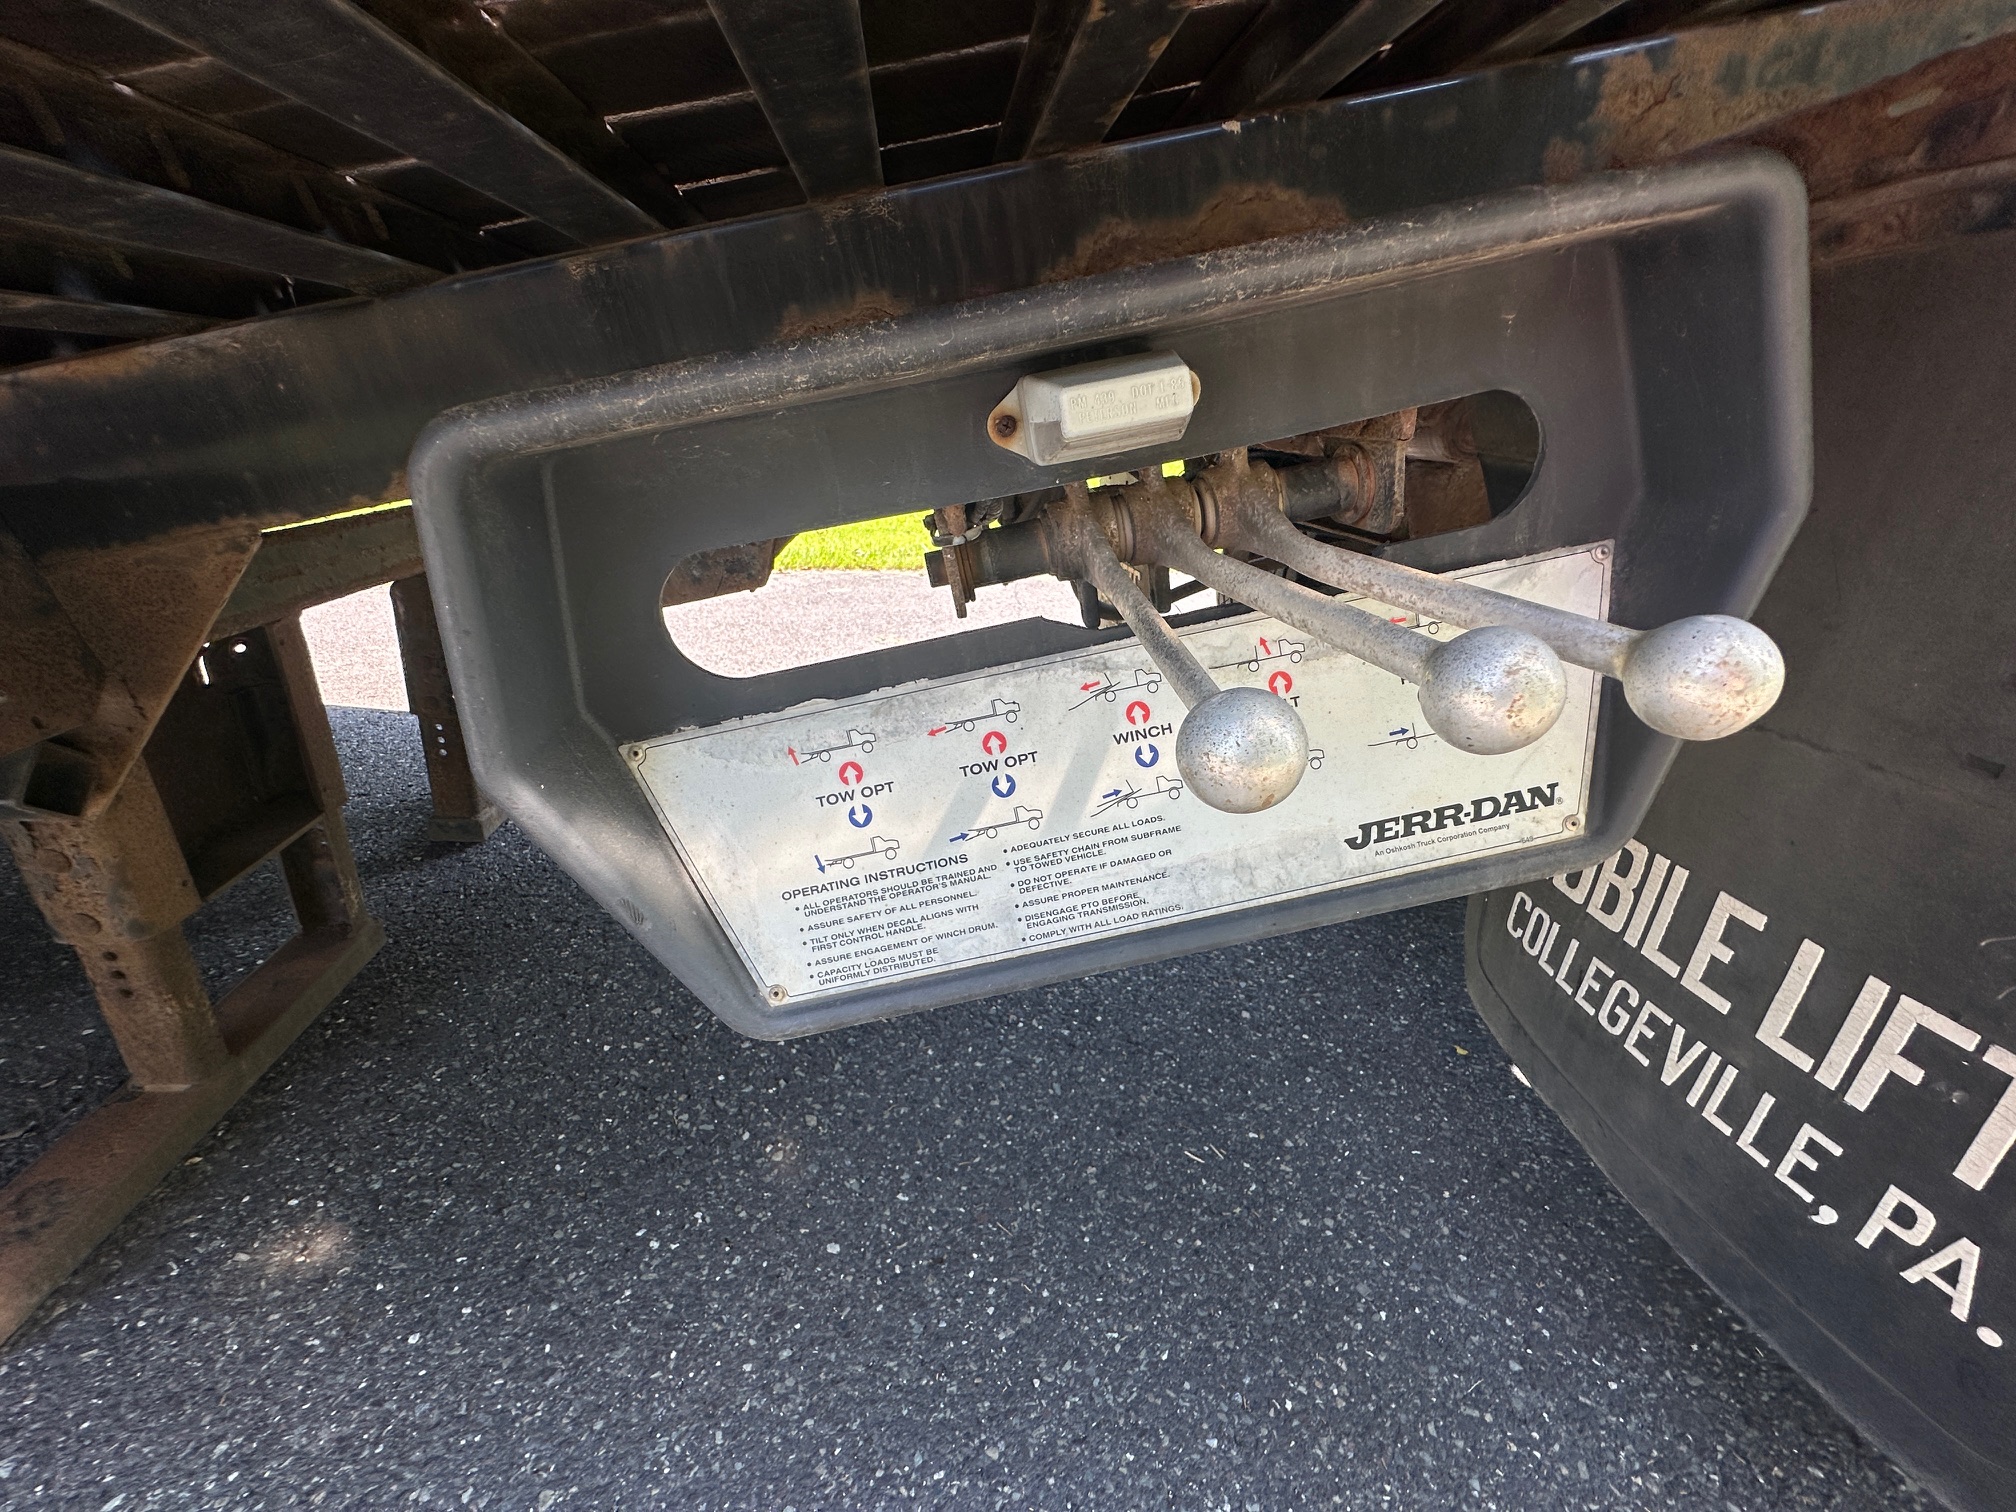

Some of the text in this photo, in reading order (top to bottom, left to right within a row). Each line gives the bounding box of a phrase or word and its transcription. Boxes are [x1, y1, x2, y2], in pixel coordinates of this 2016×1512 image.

[1131, 384, 1153, 398] DOT
[1113, 723, 1173, 745] WINCH
[959, 751, 1038, 778] TOW OPT
[816, 782, 895, 808] TOW OPT
[1011, 815, 1165, 853] ADEQUATELY SECURE ALL LOADS.
[1344, 782, 1559, 850] JERR-DAN
[1013, 825, 1181, 866] USE SAFETY CHAIN FROM SUBFRAME
[1374, 823, 1510, 857] An Oshkosh Truck Corporation Company
[781, 854, 968, 901] OPERATING INSTRUCTIONS
[1014, 849, 1106, 873] TO TOWED VEHICLE.
[1018, 879, 1031, 887] DO
[1033, 874, 1052, 884] NOT
[1055, 864, 1098, 880] OPERATE
[1110, 853, 1156, 868] DAMAGED
[1159, 849, 1172, 857] OR
[803, 864, 997, 911] ALL OPERATORS SHOULD BE TRAINED AND
[804, 873, 991, 917] UNDERSTAND THE OPERATOR'S MANUAL.
[1019, 879, 1072, 894] DEFECTIVE.
[1022, 872, 1170, 908] ASSURE PROPER MAINTENANCE.
[807, 890, 977, 931] ASSURE SAFETY OF ALL PERSONNEL.
[810, 904, 979, 945] TILT ONLY WHEN DECAL ALIGNS WITH
[1025, 892, 1139, 922] DISENGAGE PTO BEFORE
[1026, 899, 1149, 929] ENGAGING TRANSMISSION.
[1029, 904, 1184, 942] COMPLY WITH ALL LOAD RATINGS.
[812, 924, 926, 953] FIRST CONTROL HANDLE.
[815, 922, 998, 967] ASSURE ENGAGEMENT OF WINCH DRUM.
[1548, 838, 1768, 1015] BILE
[817, 947, 939, 979] CAPACITY LOADS MUST BE
[819, 956, 936, 986] UNIFORMLY DISTRIBUTED.
[1507, 892, 2003, 1347] COLLEGEVILLE, PA.
